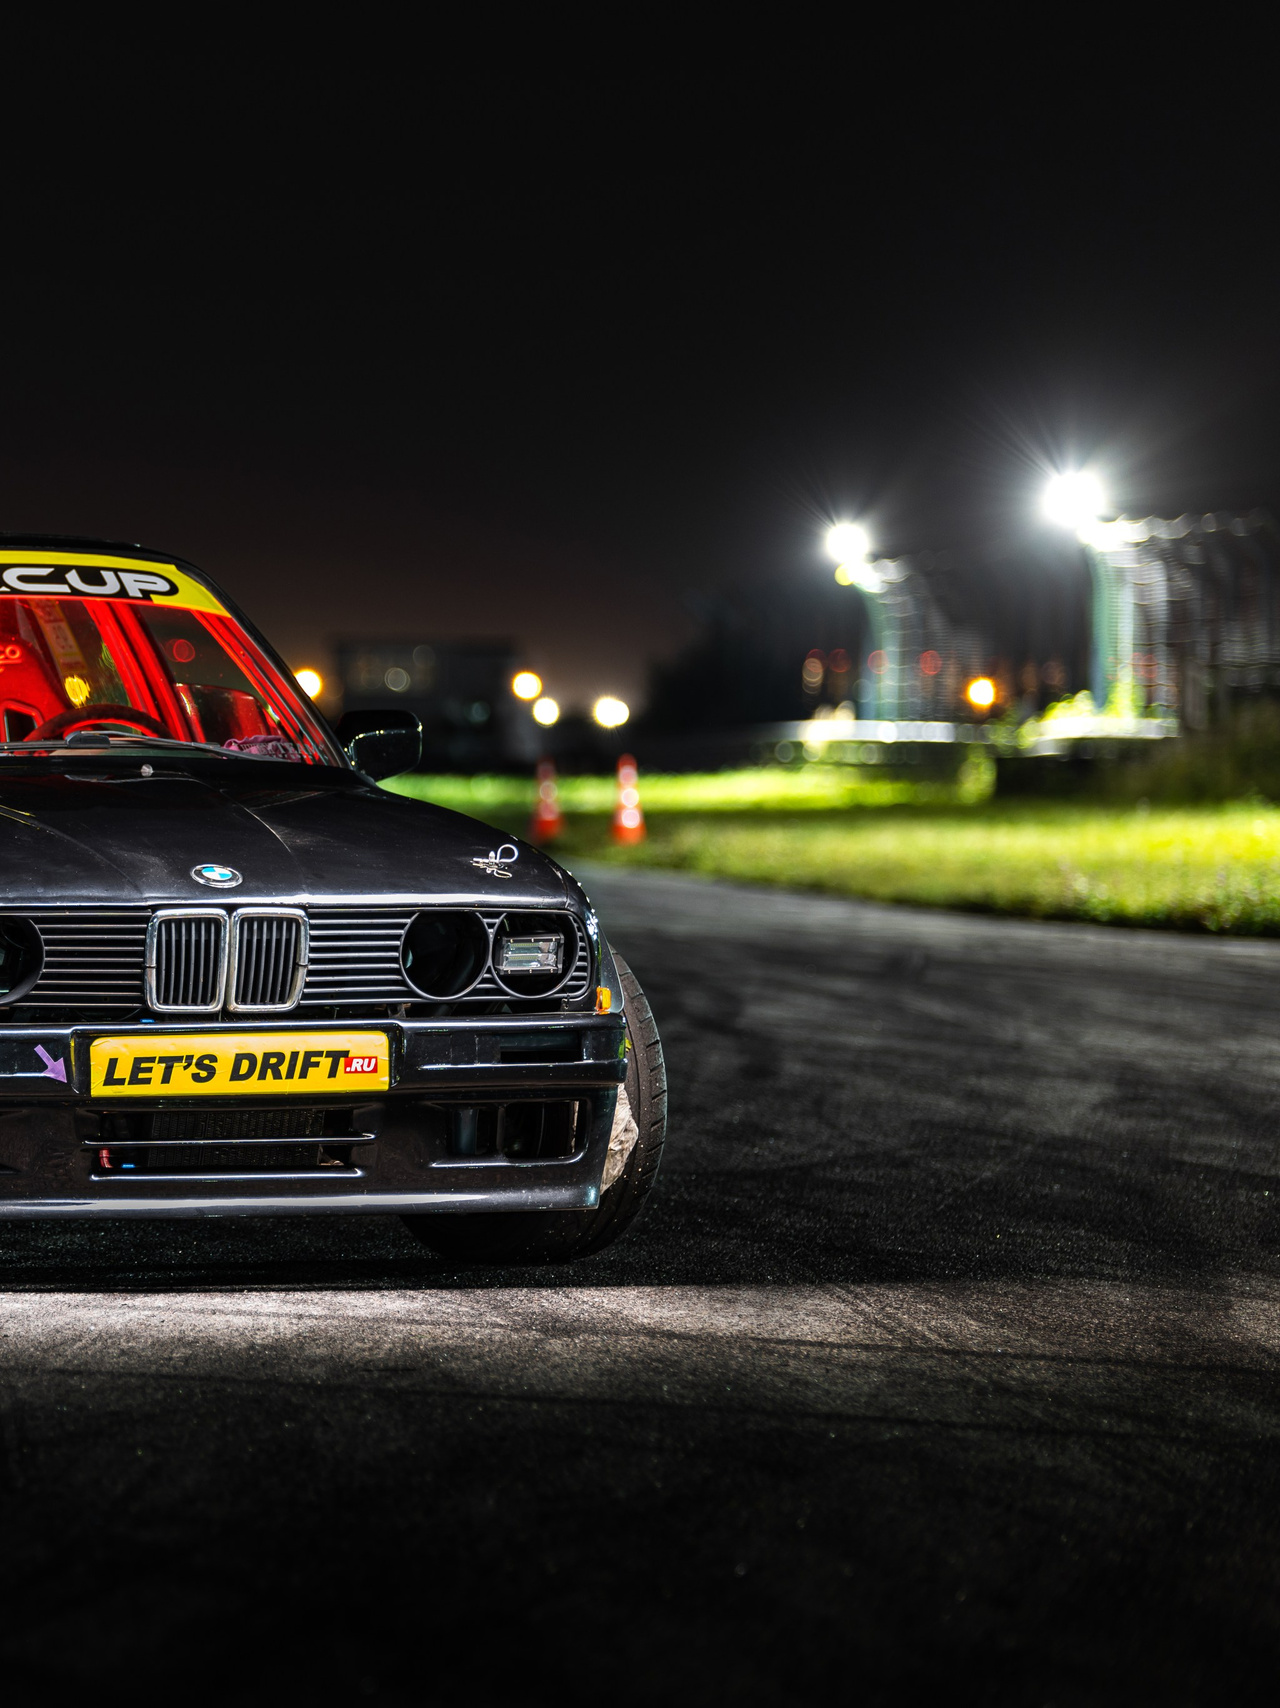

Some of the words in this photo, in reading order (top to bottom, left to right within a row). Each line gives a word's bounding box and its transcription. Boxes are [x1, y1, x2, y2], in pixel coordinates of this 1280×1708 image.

[2, 567, 171, 598] CUP
[102, 1054, 218, 1087] LET'S
[228, 1050, 350, 1082] DRIFT
